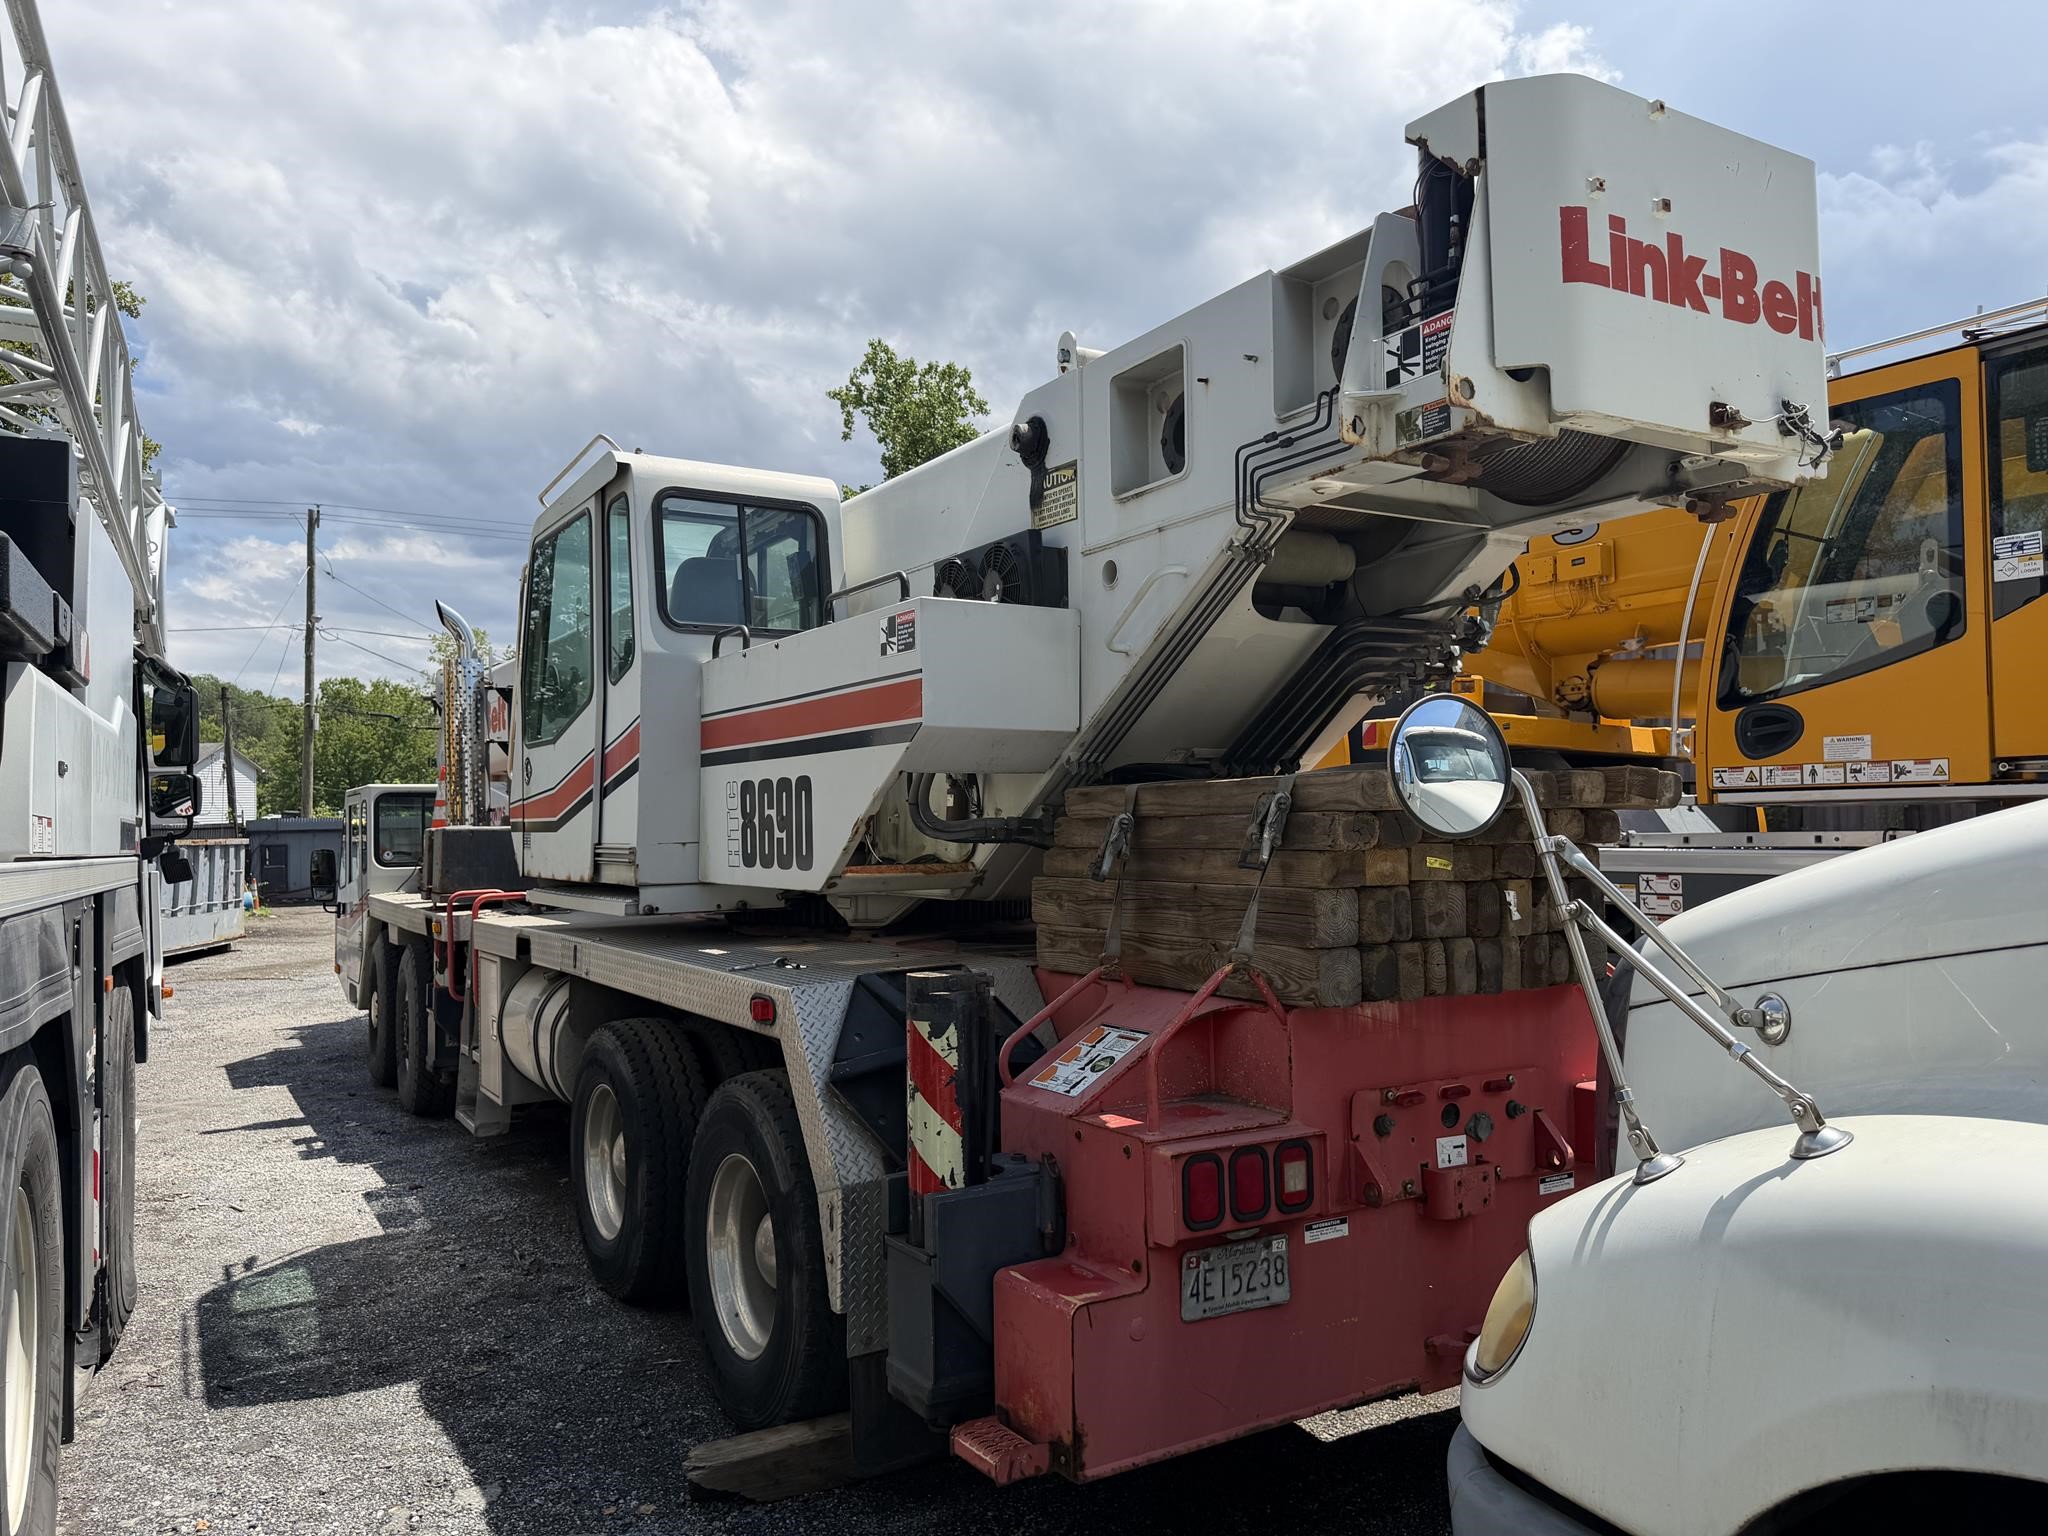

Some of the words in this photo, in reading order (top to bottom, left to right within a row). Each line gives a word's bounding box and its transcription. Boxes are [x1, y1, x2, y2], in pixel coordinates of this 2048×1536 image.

[1560, 206, 1824, 342] Link-Belt
[740, 775, 813, 871] 8690
[1189, 1255, 1285, 1304] 4E15238
